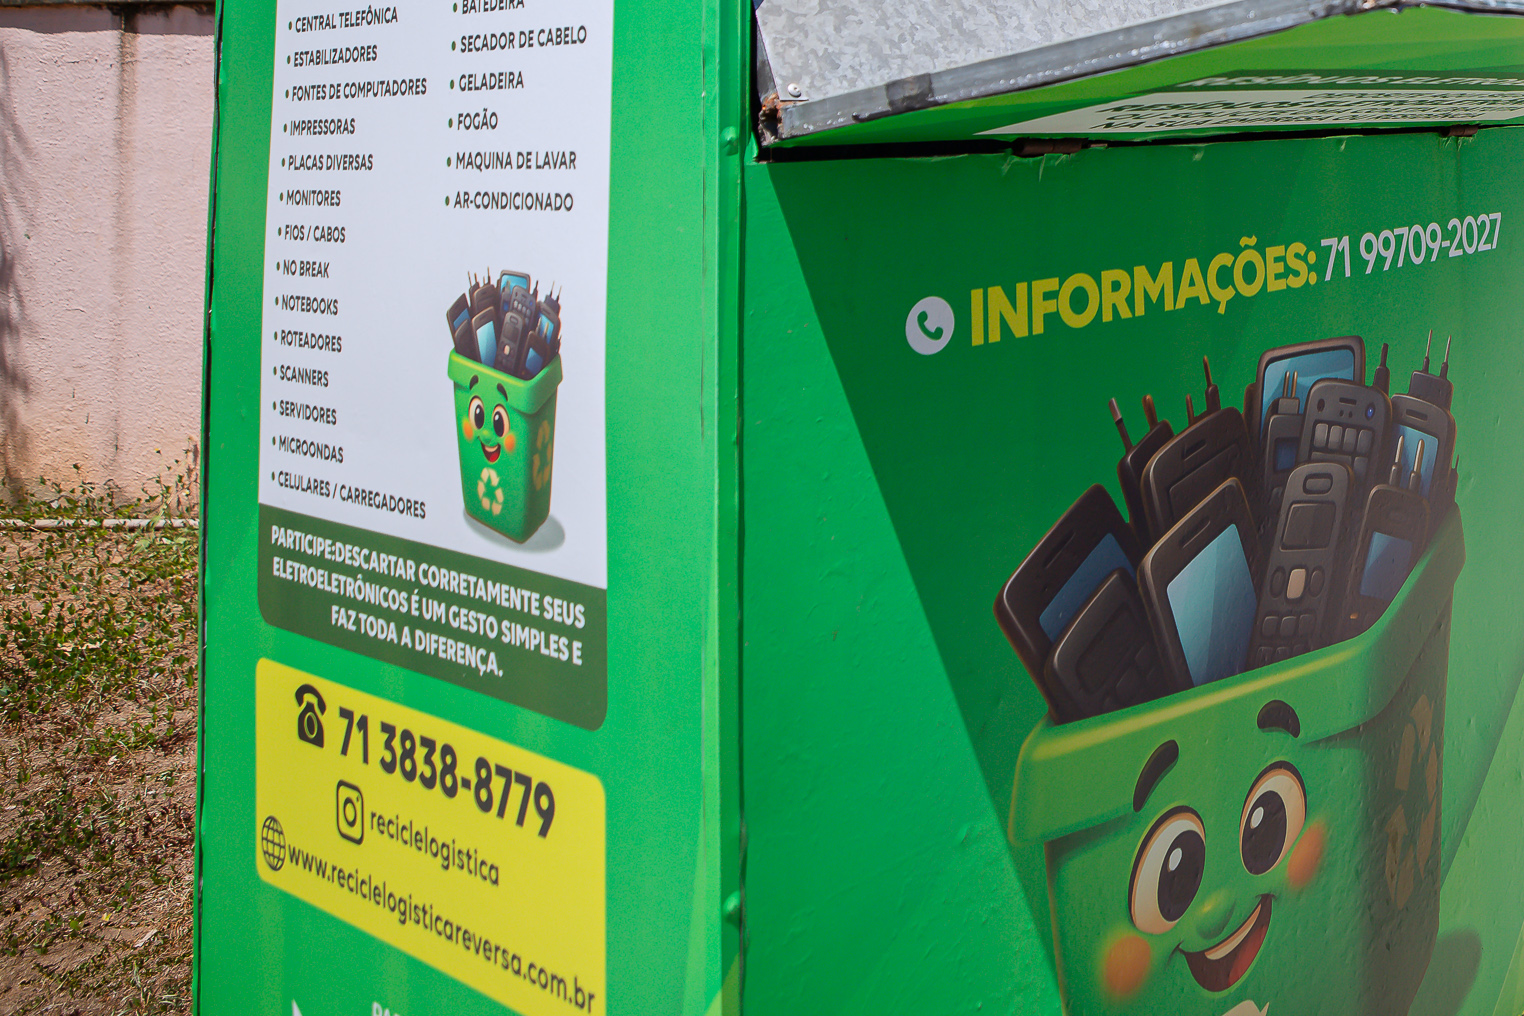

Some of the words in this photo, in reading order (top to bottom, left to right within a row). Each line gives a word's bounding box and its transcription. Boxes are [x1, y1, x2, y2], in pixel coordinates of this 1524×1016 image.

[295, 14, 337, 33] CENTRAL
[338, 5, 398, 28] TELEFÔNICA
[460, 32, 516, 53] SECADOR
[518, 30, 535, 48] DE
[537, 26, 587, 46] CABELO
[293, 45, 378, 67] ESTABILIZADORES
[291, 84, 327, 101] FONTES
[328, 83, 342, 99] DE
[343, 78, 427, 99] COMPUTADORES
[458, 71, 524, 91] GELADEIRA
[289, 118, 356, 135] IMPRESSORAS
[457, 108, 499, 130] FOGÃO
[288, 155, 324, 170] PLACAS
[325, 154, 374, 170] DIVERSAS
[455, 152, 513, 171] MAQUINA
[516, 152, 533, 169] DE
[535, 151, 577, 169] LAVAR
[286, 190, 341, 206] MONITORES
[453, 191, 574, 211] AR-CONDICIONADO
[284, 225, 305, 241] FIOS
[306, 226, 312, 241] /
[313, 226, 346, 243] CABOS
[282, 260, 298, 275] NO
[299, 261, 330, 278] BREAK
[969, 234, 1318, 347] INFORMAÇÕES:
[1321, 238, 1351, 283] 71
[1359, 212, 1502, 277] 99709-2027
[281, 295, 339, 315] NOTEBOOKS
[280, 330, 342, 352] ROTEADORES
[279, 365, 329, 387] SCANNERS
[279, 400, 337, 425] SERVIDORES
[278, 435, 344, 463] MICROONDAS
[277, 471, 331, 497] CELULARES
[332, 484, 338, 498] /
[339, 485, 426, 519] CARREGADORES
[271, 525, 416, 582] PARTICIPE:DESCARTAR
[418, 563, 540, 617] CORRETAMENTE
[543, 595, 585, 629] SEUS
[273, 558, 408, 614] ELETROELETRÔNICOS
[411, 588, 420, 616] É
[422, 594, 446, 623] UM
[448, 604, 498, 640] GESTO
[501, 624, 570, 660] SIMPLES
[573, 641, 583, 666] E
[331, 605, 357, 629] FAZ
[358, 612, 398, 644] TODA
[401, 624, 412, 646] A
[414, 628, 504, 678] DIFERENÇA.
[338, 706, 370, 765] 71
[380, 720, 556, 839] 3838-8779
[370, 806, 500, 886] reciclelogistica
[288, 843, 595, 1015] www.reciclelogisticareversa.com.br
